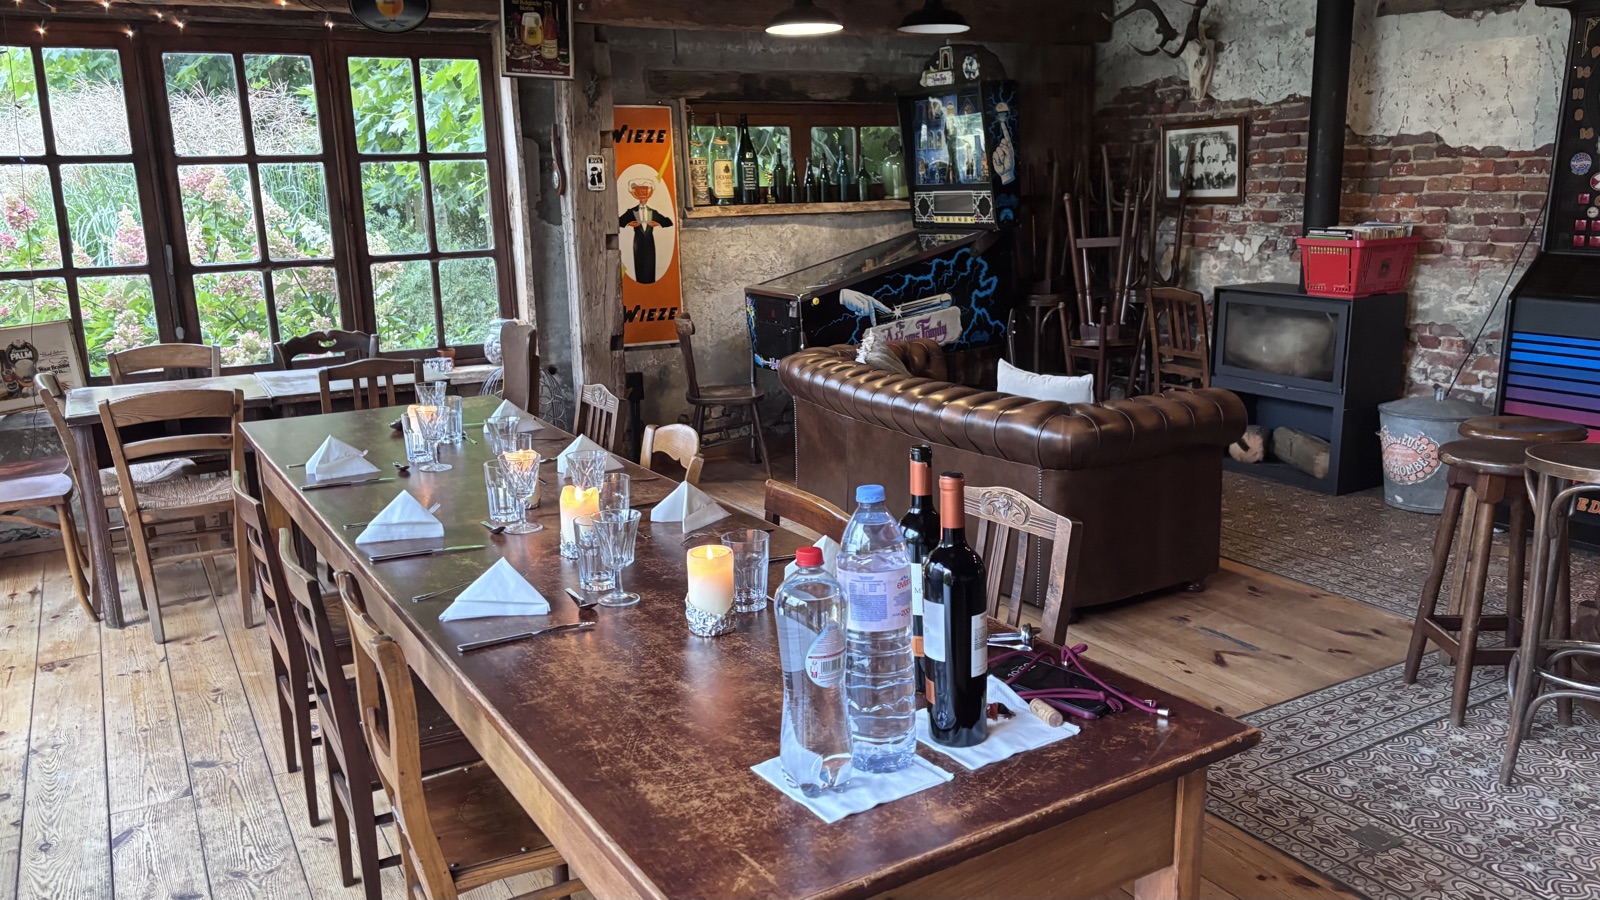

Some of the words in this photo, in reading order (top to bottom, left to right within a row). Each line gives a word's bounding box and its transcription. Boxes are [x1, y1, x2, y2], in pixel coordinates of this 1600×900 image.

[613, 125, 666, 143] WIEZE
[623, 305, 677, 322] WIEZE
[915, 315, 947, 342] Family
[10, 350, 33, 360] PALM
